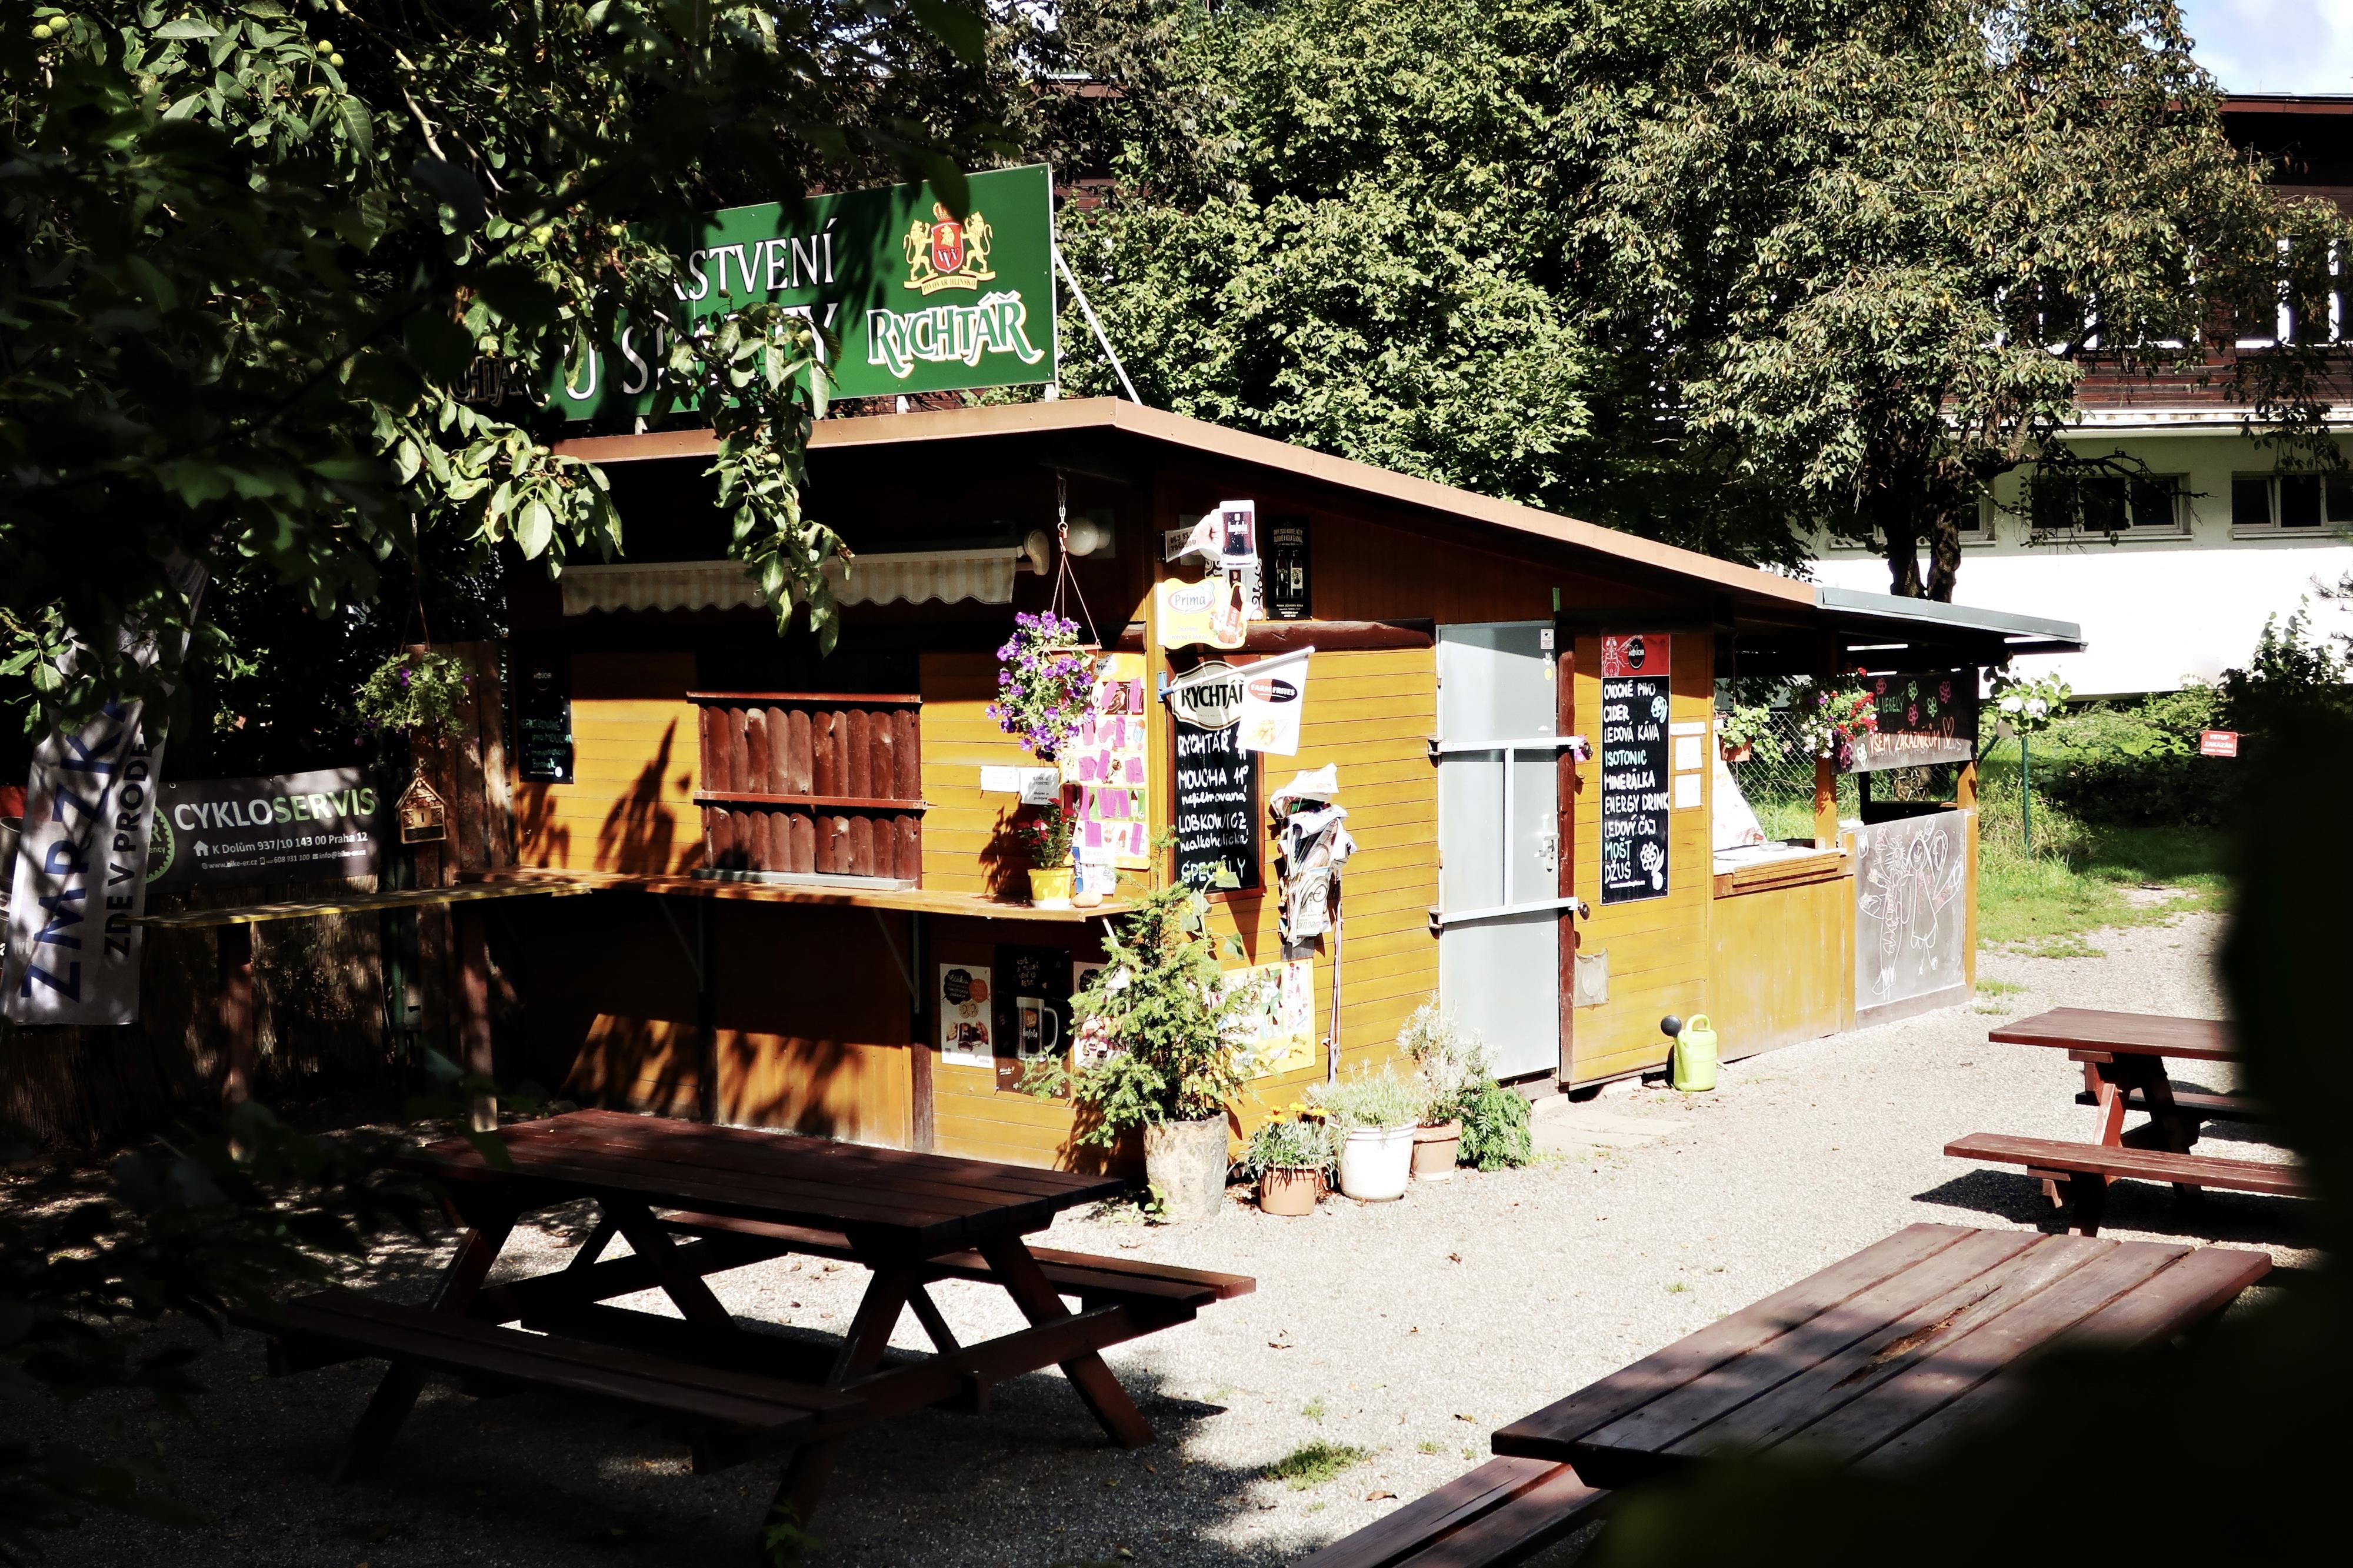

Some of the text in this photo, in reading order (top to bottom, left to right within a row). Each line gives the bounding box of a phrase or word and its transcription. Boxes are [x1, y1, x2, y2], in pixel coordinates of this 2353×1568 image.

[673, 218, 834, 302] STVENÍ
[923, 278, 976, 292] PIVOVAR HLINSKO
[866, 289, 1045, 379] RYCHTÁŘ
[1175, 594, 1206, 606] Prima
[1251, 683, 1295, 696] FARM FRITES
[1604, 679, 1657, 700] OVOCNÉ PIVO
[1603, 704, 1630, 723] CIDER
[1882, 690, 1906, 714] VESELÝ
[1177, 728, 1232, 757] RYCHTÁŘ
[1604, 720, 1660, 744] LEDOVÁ KÁVA
[1605, 749, 1648, 768] ISOTONIC
[1178, 766, 1227, 790] MOUCHA
[1604, 768, 1656, 791] MINERÁLKA
[174, 788, 376, 830] CYKLOSERVIS
[1605, 792, 1669, 815] ENERGY DRINK
[1178, 811, 1247, 834] LOBKOWICZ
[1604, 813, 1657, 839] LEDOVÝ ČAJ
[104, 738, 152, 958] ZDE V PRODE
[212, 831, 368, 855] K Dolům 937/10 143 00 Praha 12
[1604, 837, 1632, 860] MOŠT
[208, 859, 258, 869] www.bike-er.cz
[1604, 859, 1632, 885] DŽUS
